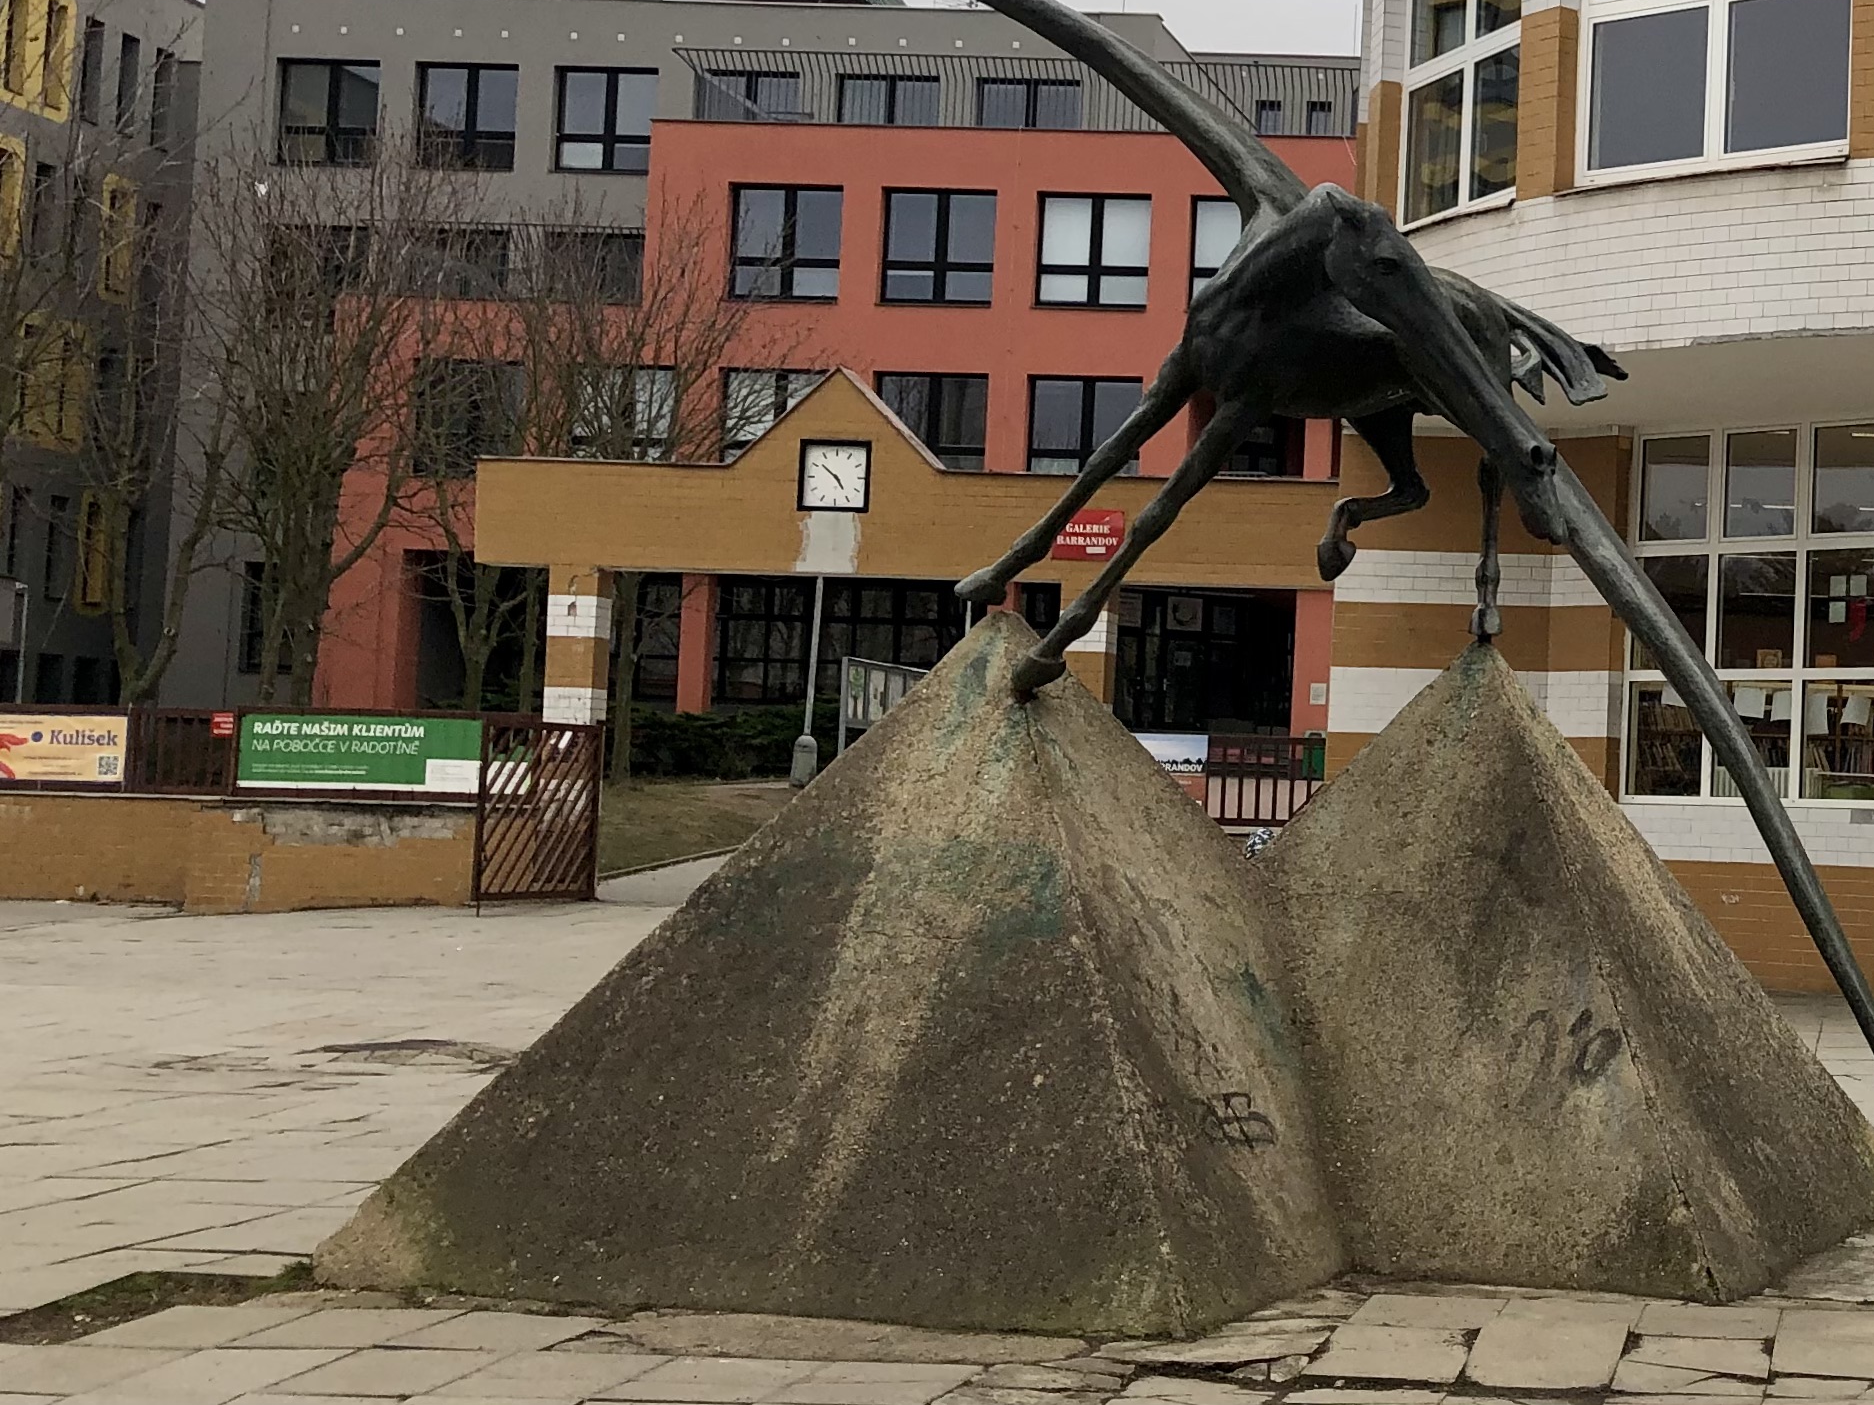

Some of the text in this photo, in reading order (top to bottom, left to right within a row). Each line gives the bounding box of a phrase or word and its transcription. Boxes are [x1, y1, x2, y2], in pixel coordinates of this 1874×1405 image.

[1065, 523, 1110, 534] GALERIE
[1056, 535, 1118, 546] BARRANDOV
[253, 720, 425, 738] RAĎTE NAŠIM KLIENTŮM
[251, 739, 271, 751] NA
[339, 741, 350, 753] V
[1161, 762, 1203, 772] RANDOV
